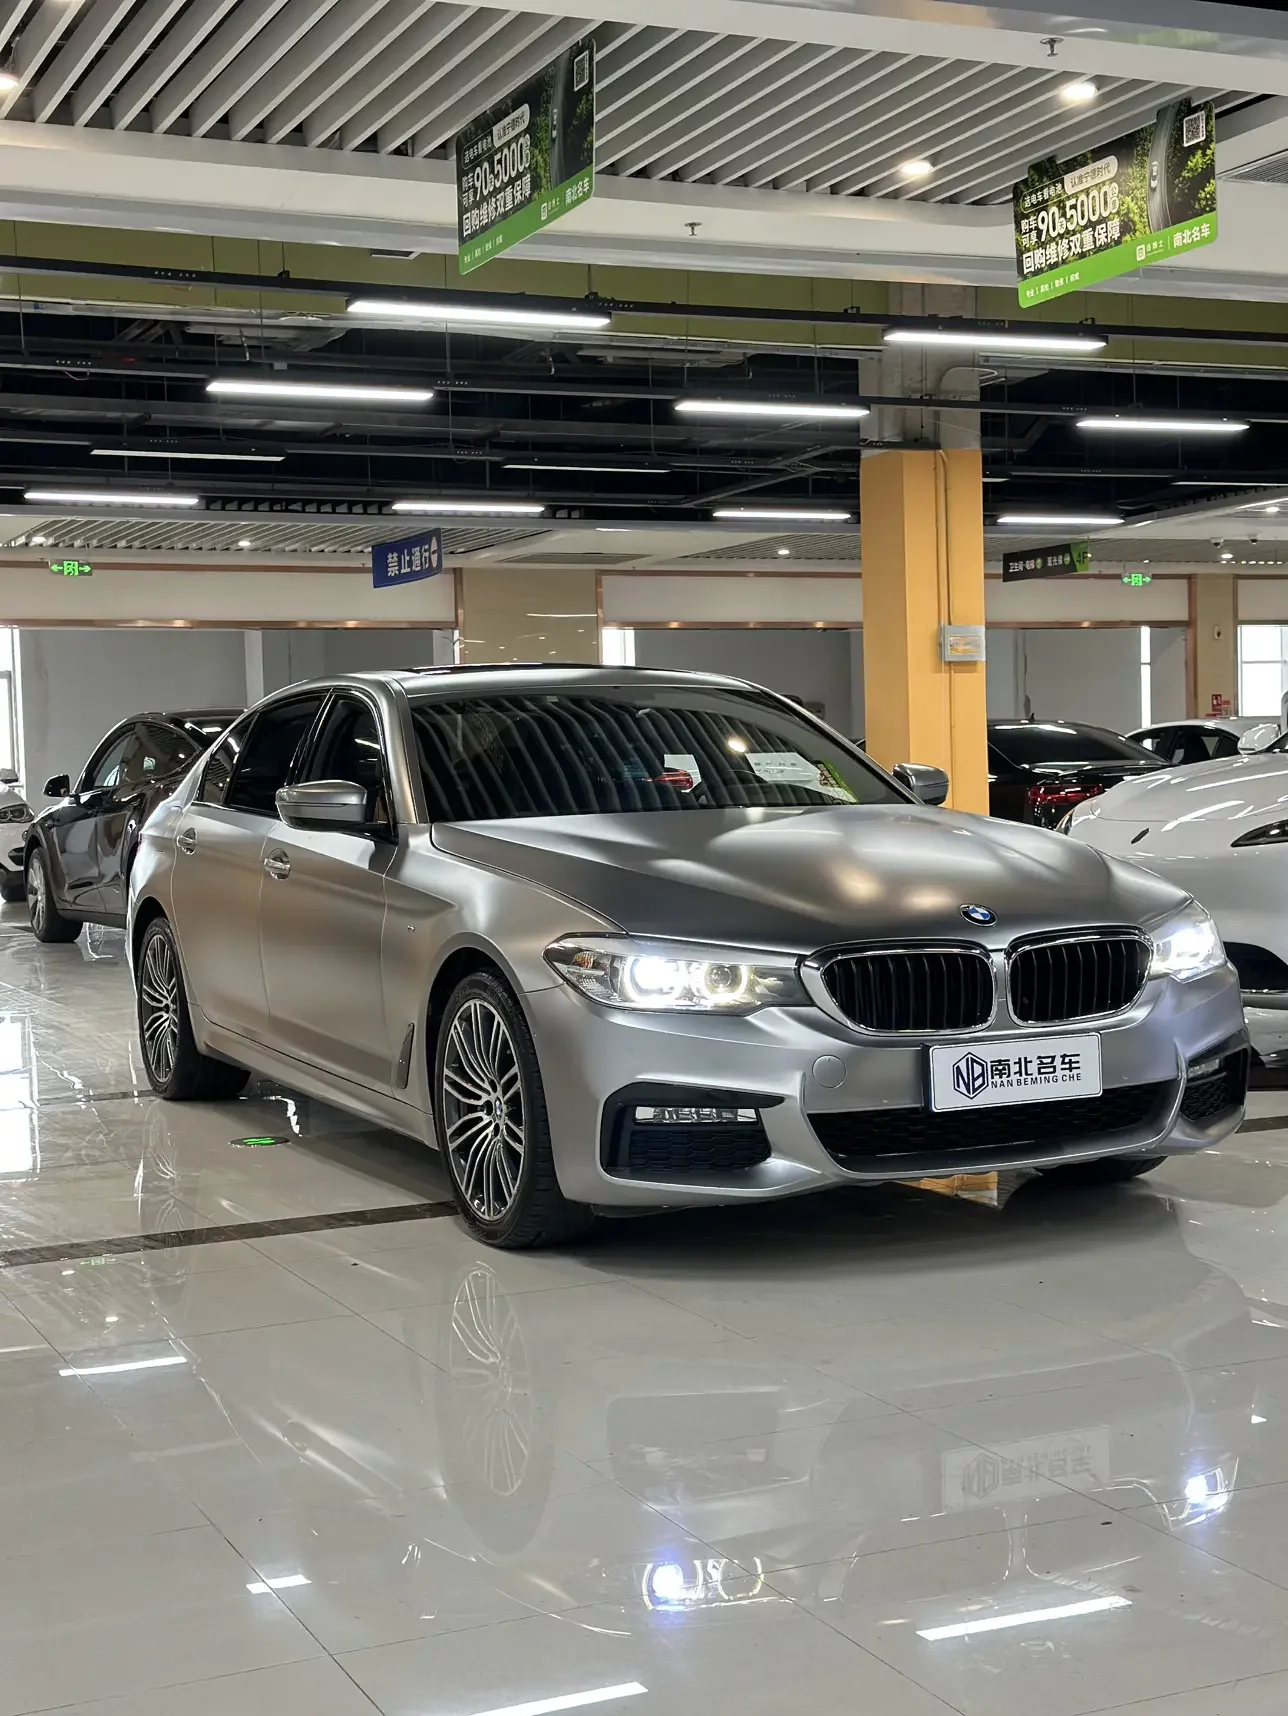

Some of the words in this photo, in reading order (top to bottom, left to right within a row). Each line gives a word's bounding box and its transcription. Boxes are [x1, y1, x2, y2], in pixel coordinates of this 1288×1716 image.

[462, 173, 474, 192] 购车
[1069, 162, 1111, 189] 认准宁德时代
[462, 191, 474, 208] 可享
[565, 176, 590, 206] 南北名车
[462, 173, 532, 238] 回购维修双重保障
[1020, 215, 1038, 233] 购车
[1173, 223, 1211, 249] 南北名车
[1021, 231, 1038, 247] 可享
[1022, 219, 1121, 275] 回购维修双重保障
[387, 544, 430, 577] 禁止通行
[990, 1053, 1081, 1080] 南北名车
[991, 1080, 1014, 1089] NAN
[1061, 1073, 1082, 1083] CHE
